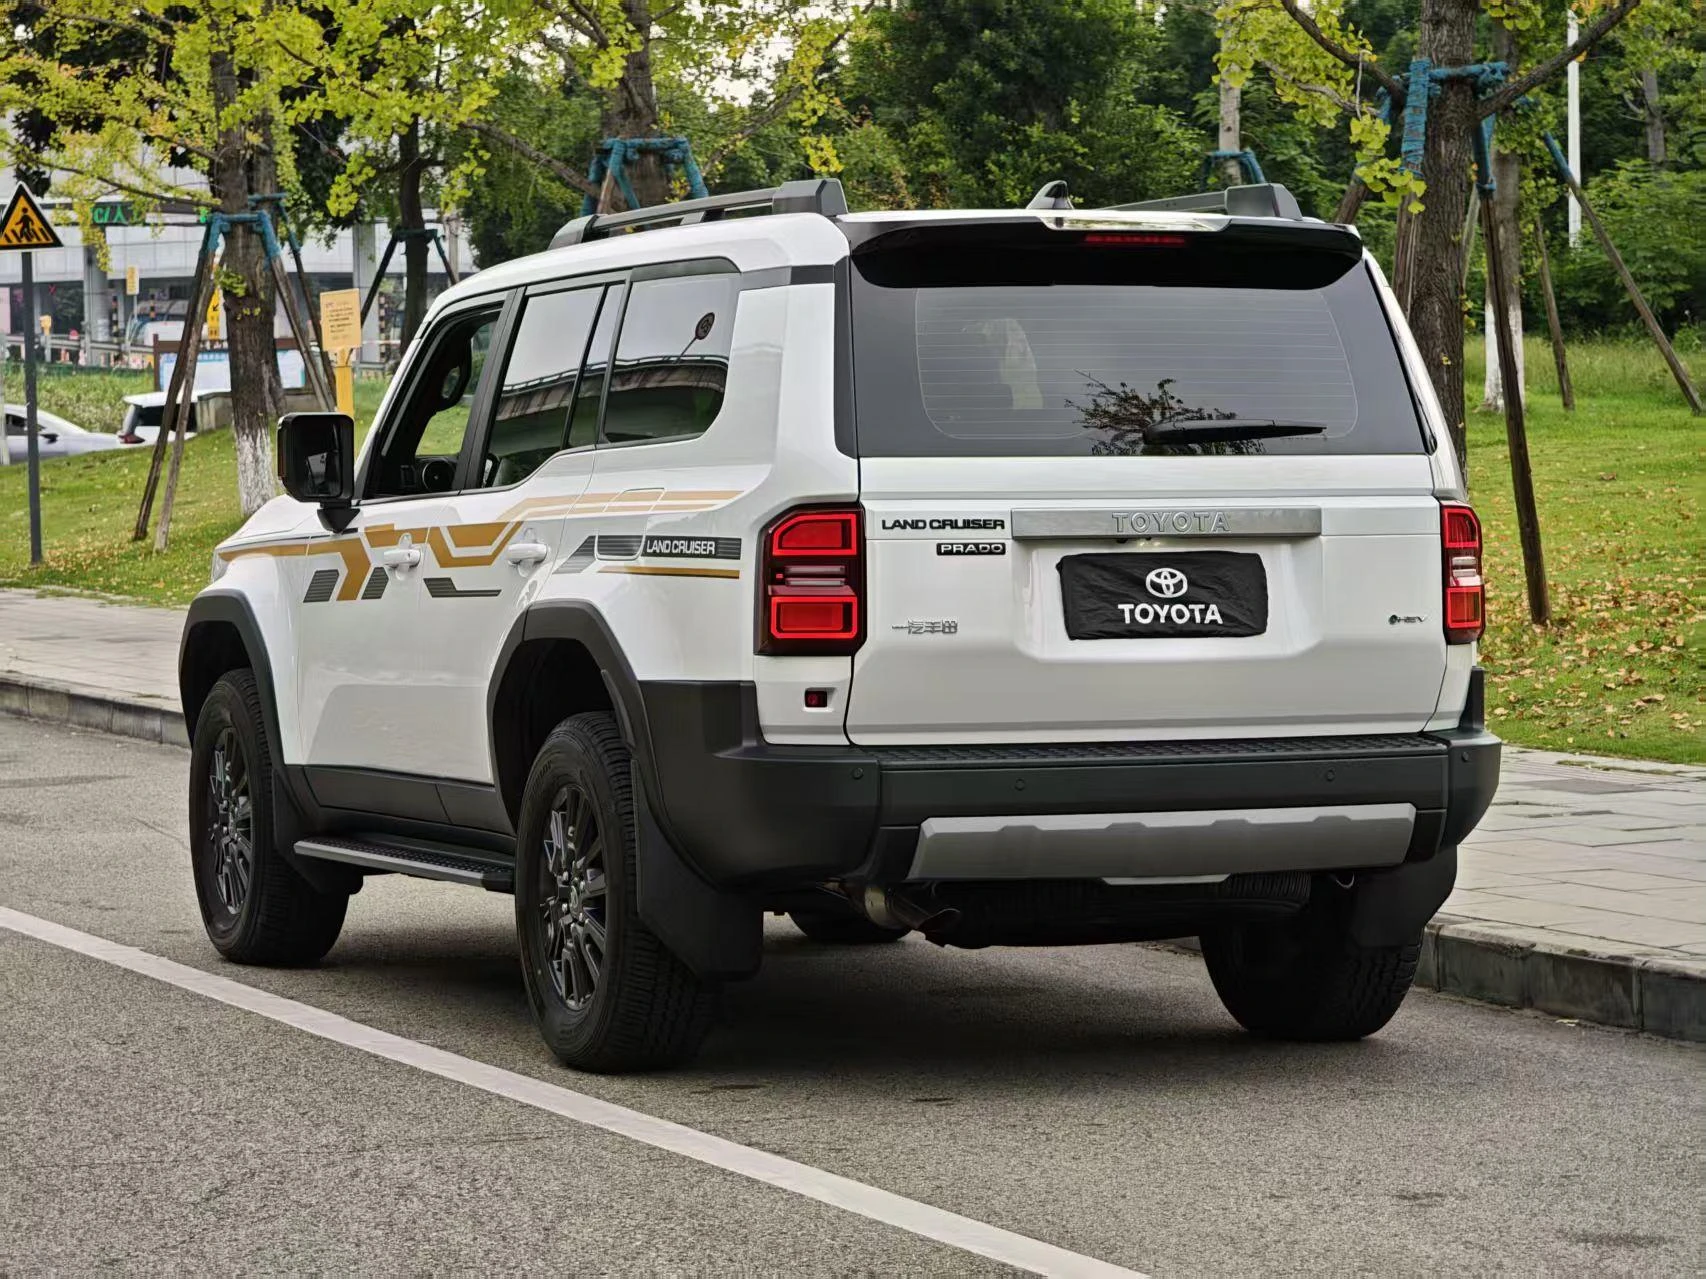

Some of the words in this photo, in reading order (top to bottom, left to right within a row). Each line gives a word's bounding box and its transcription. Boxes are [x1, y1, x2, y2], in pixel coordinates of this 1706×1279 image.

[881, 519, 927, 530] LAND
[929, 519, 1005, 530] CRUISER
[1111, 511, 1231, 533] TOYOTA
[646, 540, 671, 553] LAND
[672, 540, 716, 555] CRUISER
[940, 543, 1004, 554] PRADO
[1117, 603, 1223, 625] TOYOTA
